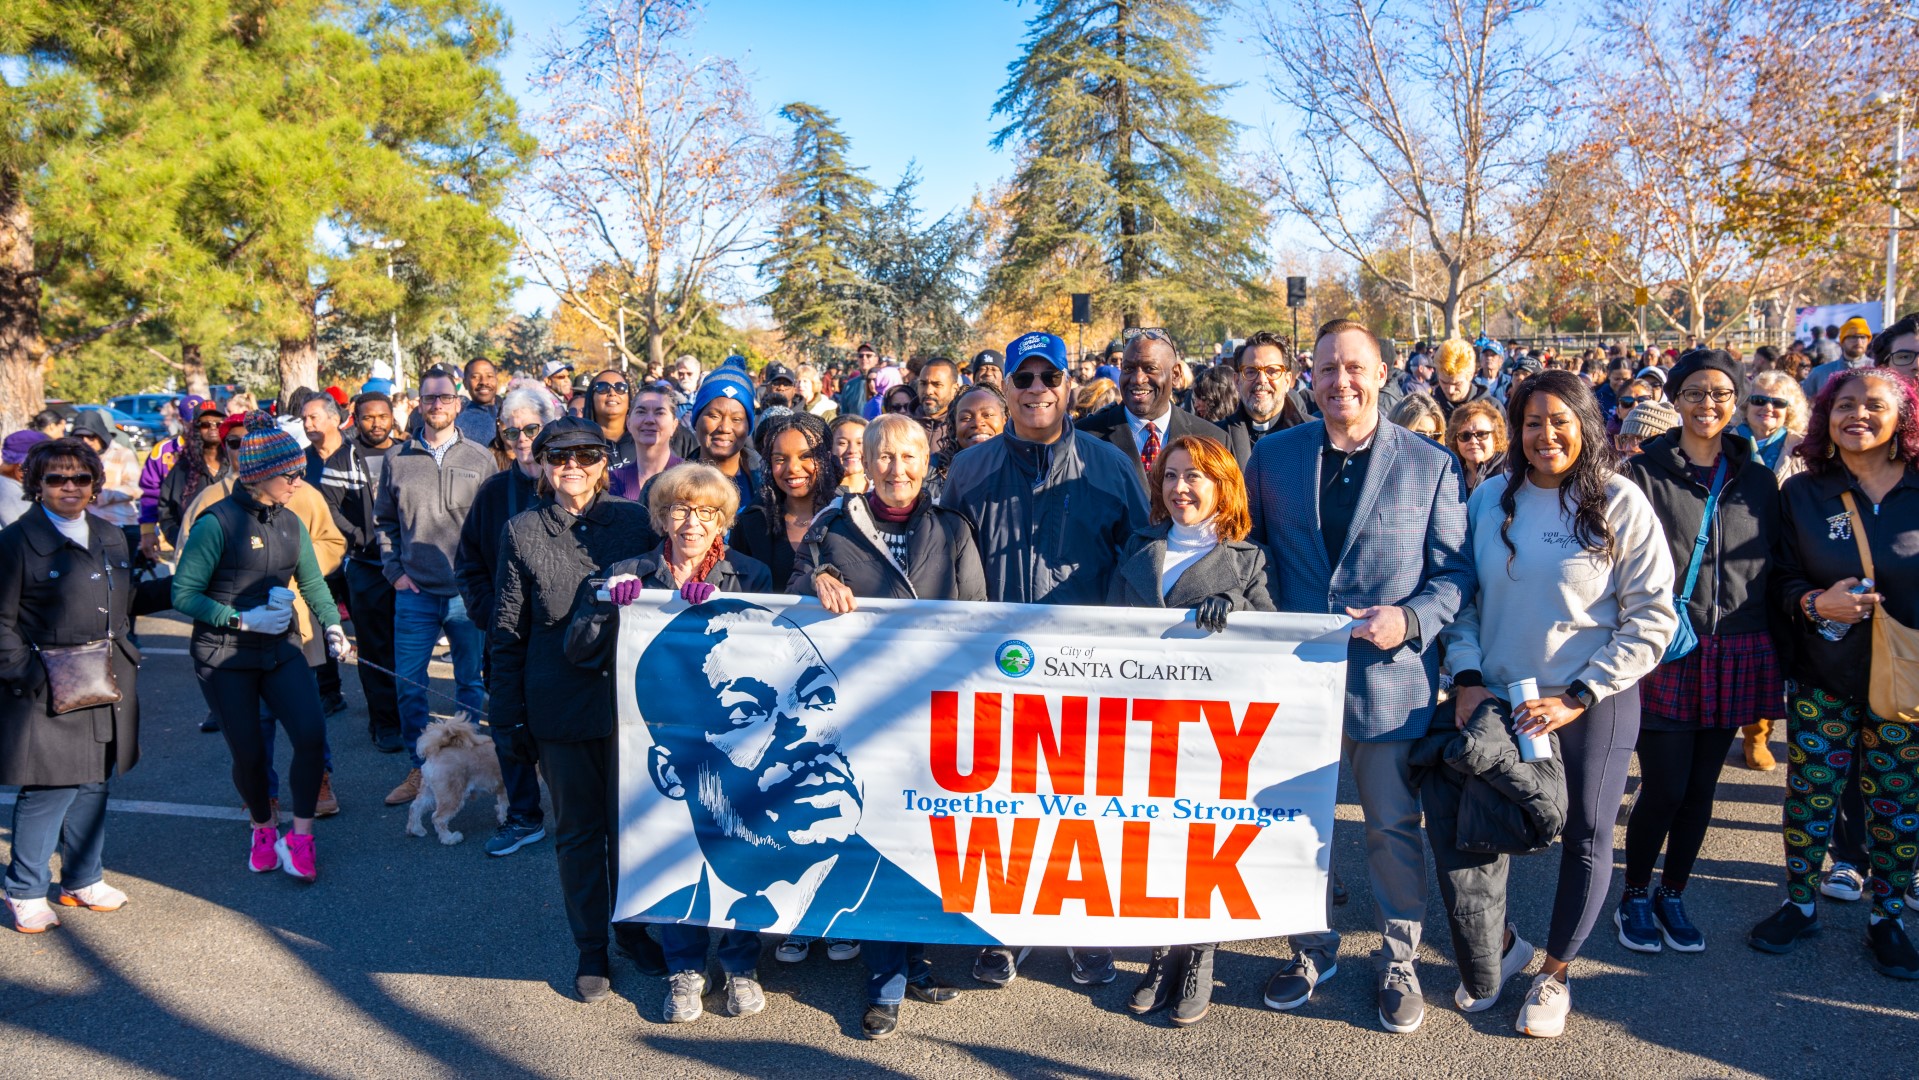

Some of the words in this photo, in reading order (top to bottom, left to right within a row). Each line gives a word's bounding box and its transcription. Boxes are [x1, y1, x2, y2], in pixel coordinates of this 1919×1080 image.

[1044, 657, 1113, 678] SANTA
[1119, 659, 1213, 681] CLARITA
[1060, 645, 1081, 658] City
[1084, 646, 1096, 659] of
[929, 691, 1280, 800] UNITY
[902, 789, 1024, 818] Together
[1037, 794, 1087, 816] We
[1101, 796, 1160, 818] Are
[1173, 798, 1302, 828] Stronger
[928, 814, 1262, 920] WALK
